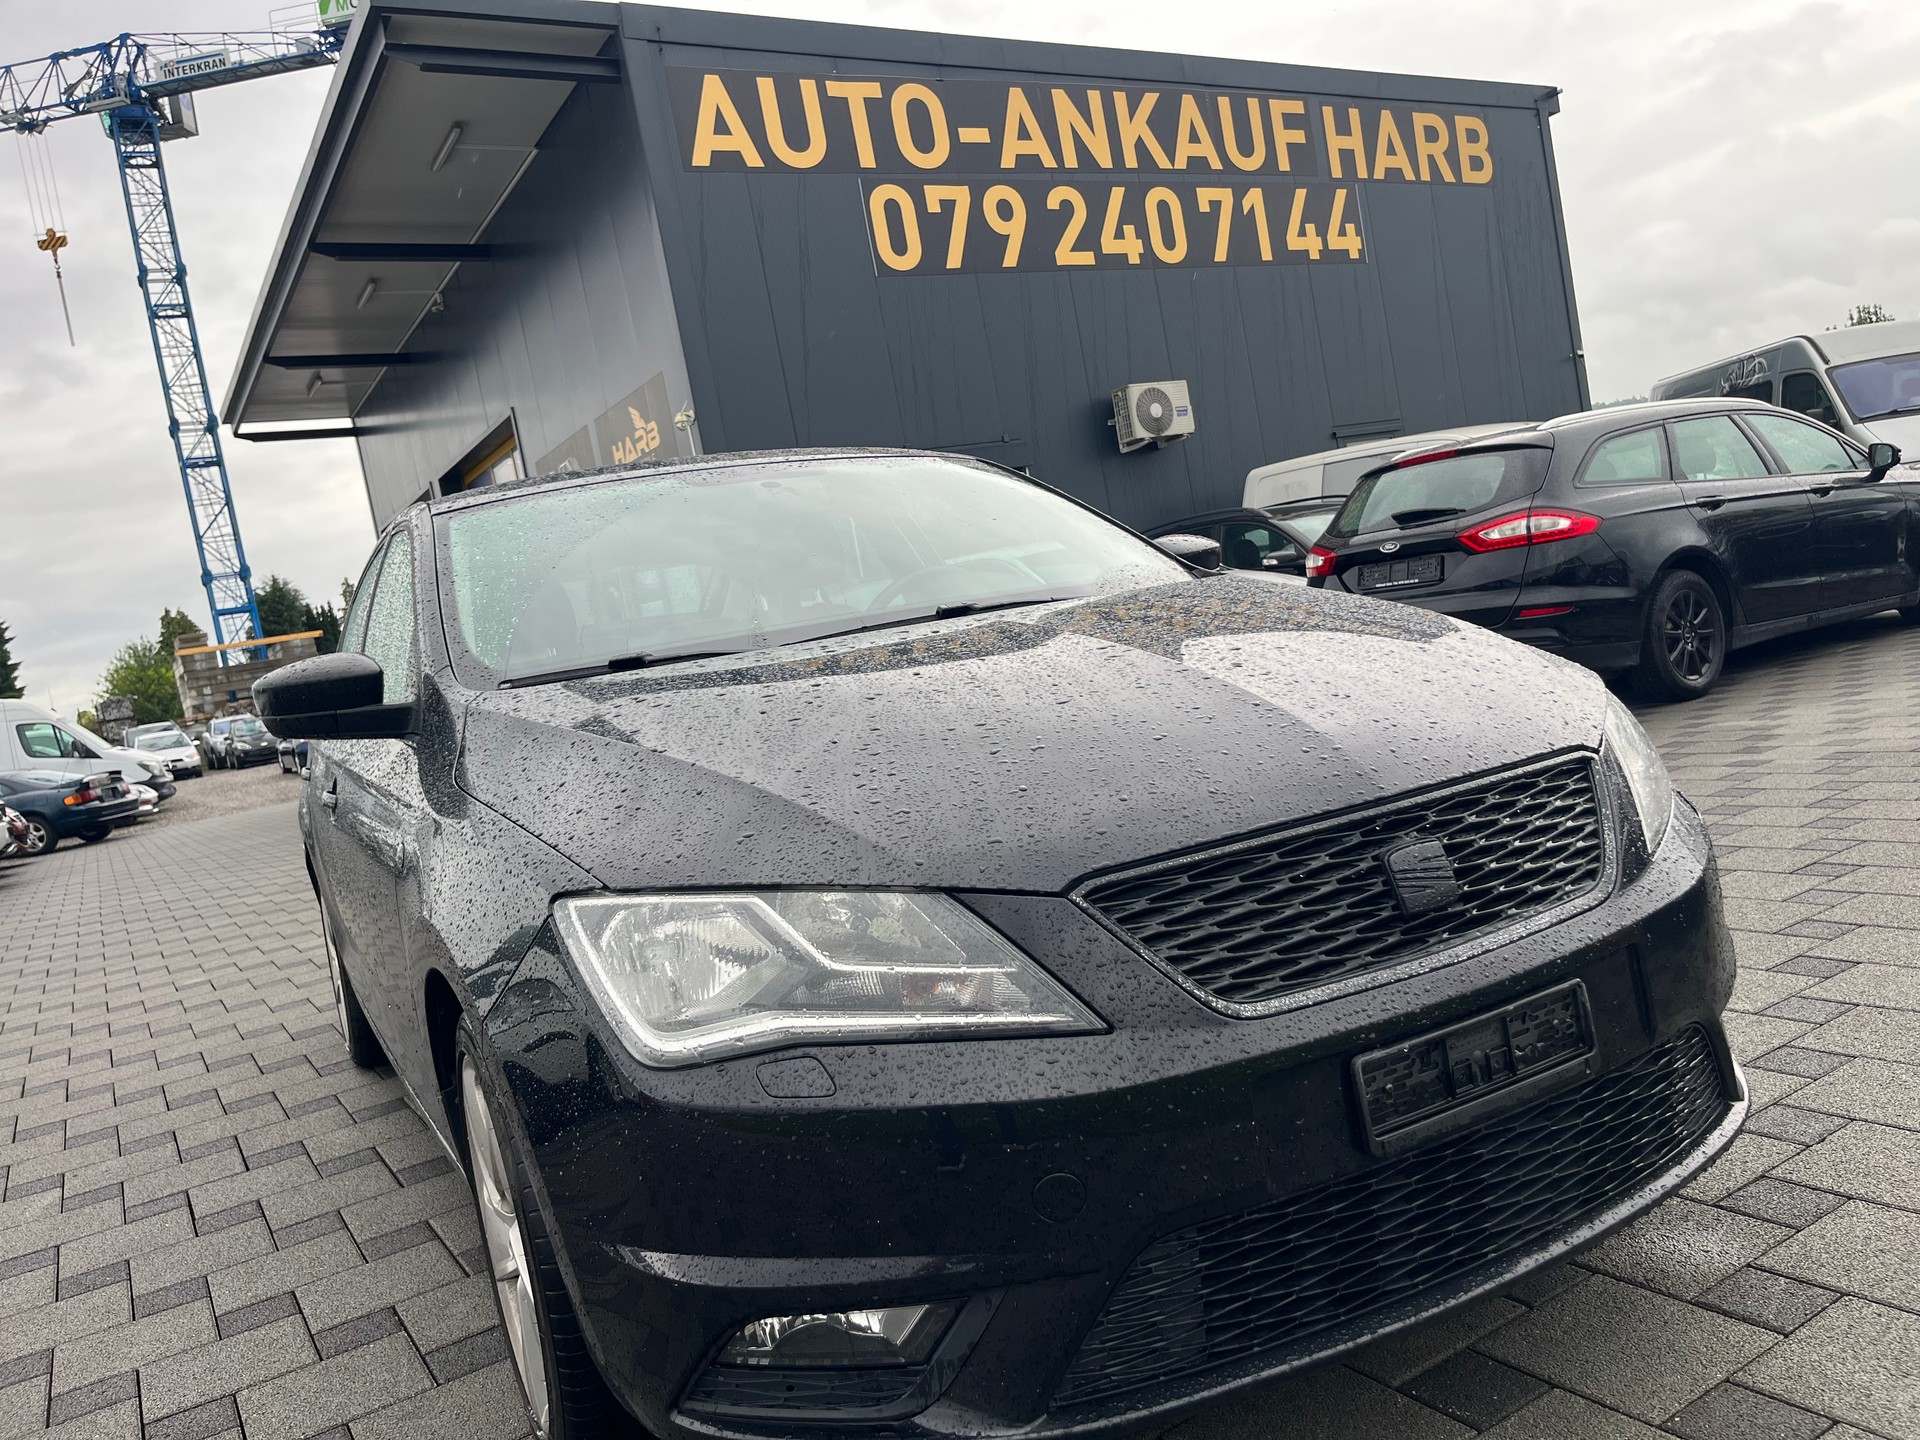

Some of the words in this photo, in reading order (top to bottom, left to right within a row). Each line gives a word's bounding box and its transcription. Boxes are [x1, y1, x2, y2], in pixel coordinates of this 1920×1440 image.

[163, 57, 226, 79] INTERKRAN
[691, 74, 1306, 171] AUTO-ANKAUF
[1322, 106, 1493, 184] HARB
[869, 183, 1027, 271] 079
[612, 420, 661, 465] HARB
